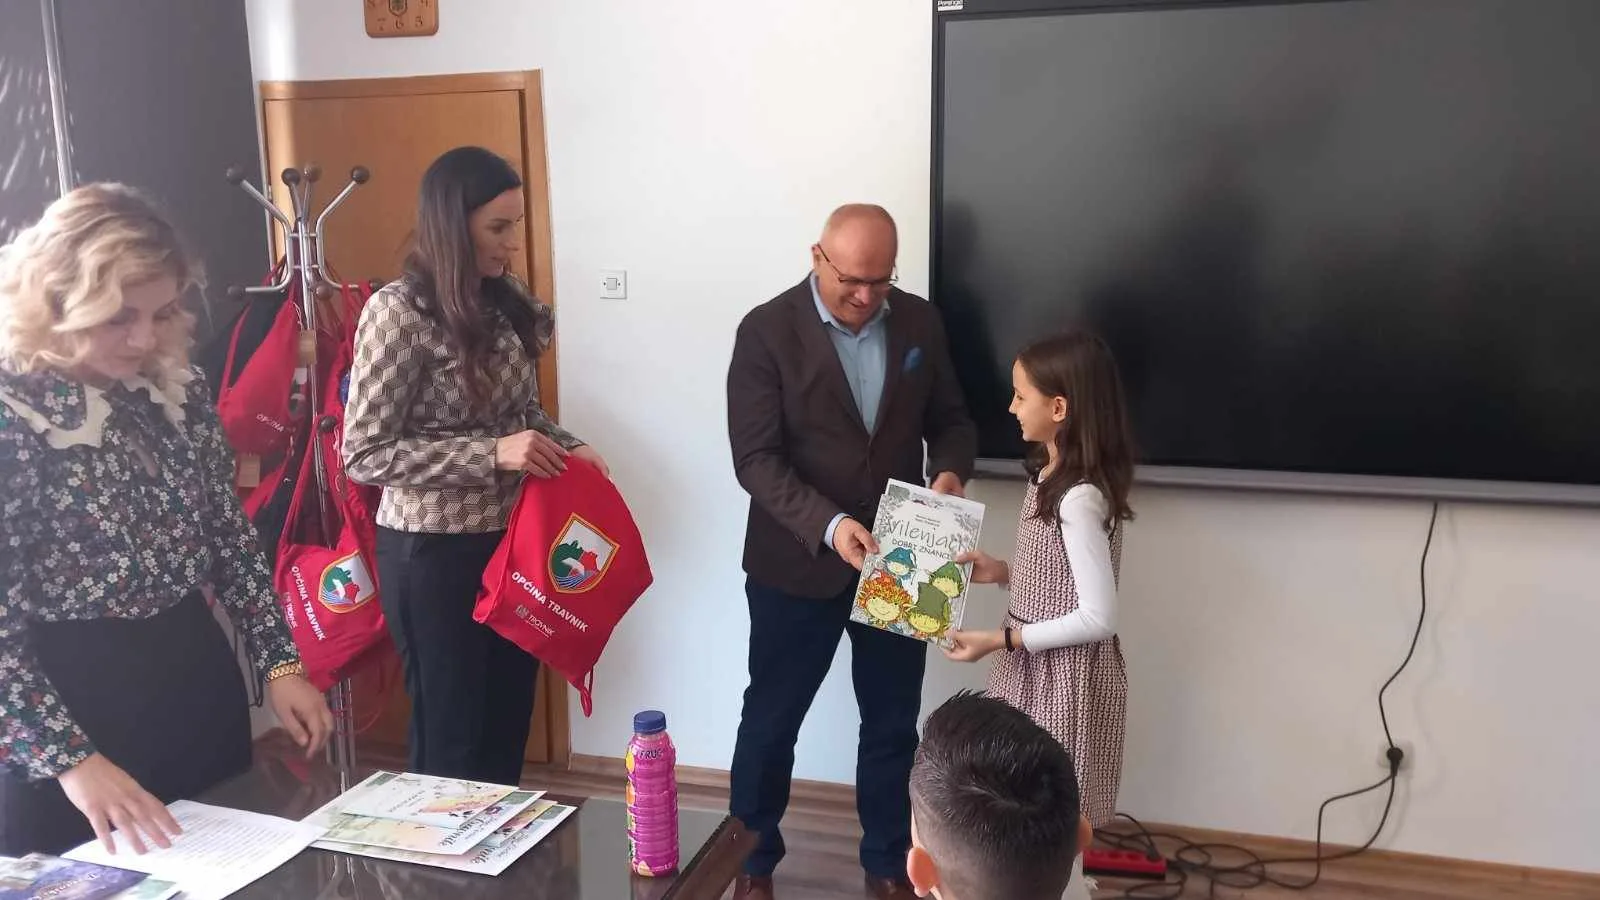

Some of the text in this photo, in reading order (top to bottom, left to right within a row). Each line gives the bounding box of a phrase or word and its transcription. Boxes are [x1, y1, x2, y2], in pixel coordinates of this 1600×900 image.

[892, 538, 952, 560] DOBRI ZNANCI
[304, 601, 326, 640] TRAVNIK
[511, 571, 547, 605] OPĆINA
[547, 600, 589, 633] TRAVNIK
